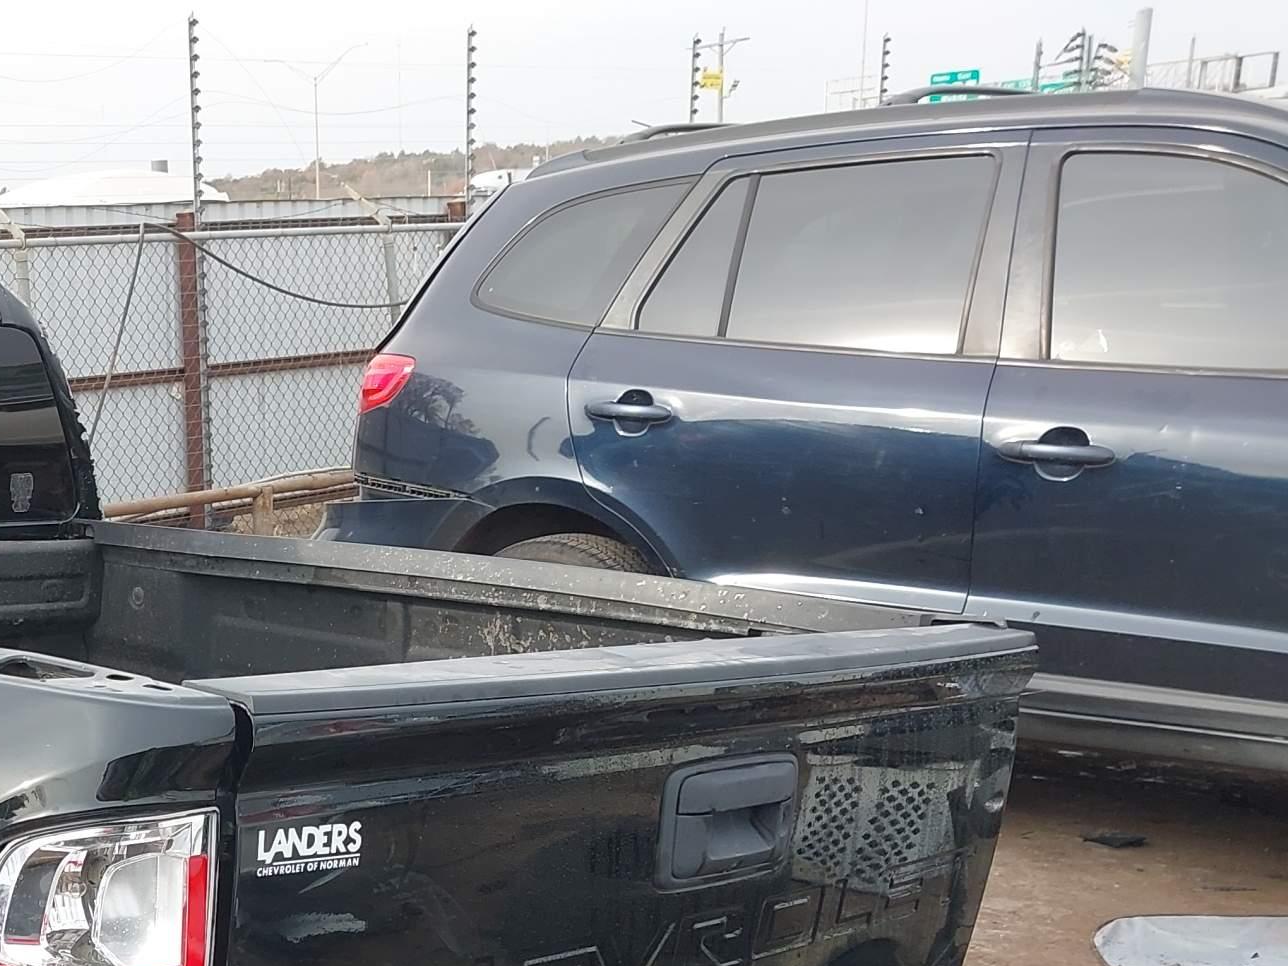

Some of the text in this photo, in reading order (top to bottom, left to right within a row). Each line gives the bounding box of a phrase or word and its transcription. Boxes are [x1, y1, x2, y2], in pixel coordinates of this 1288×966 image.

[257, 821, 362, 864] LANDERS
[256, 857, 360, 877] CHEVROLET OF NORMAN
